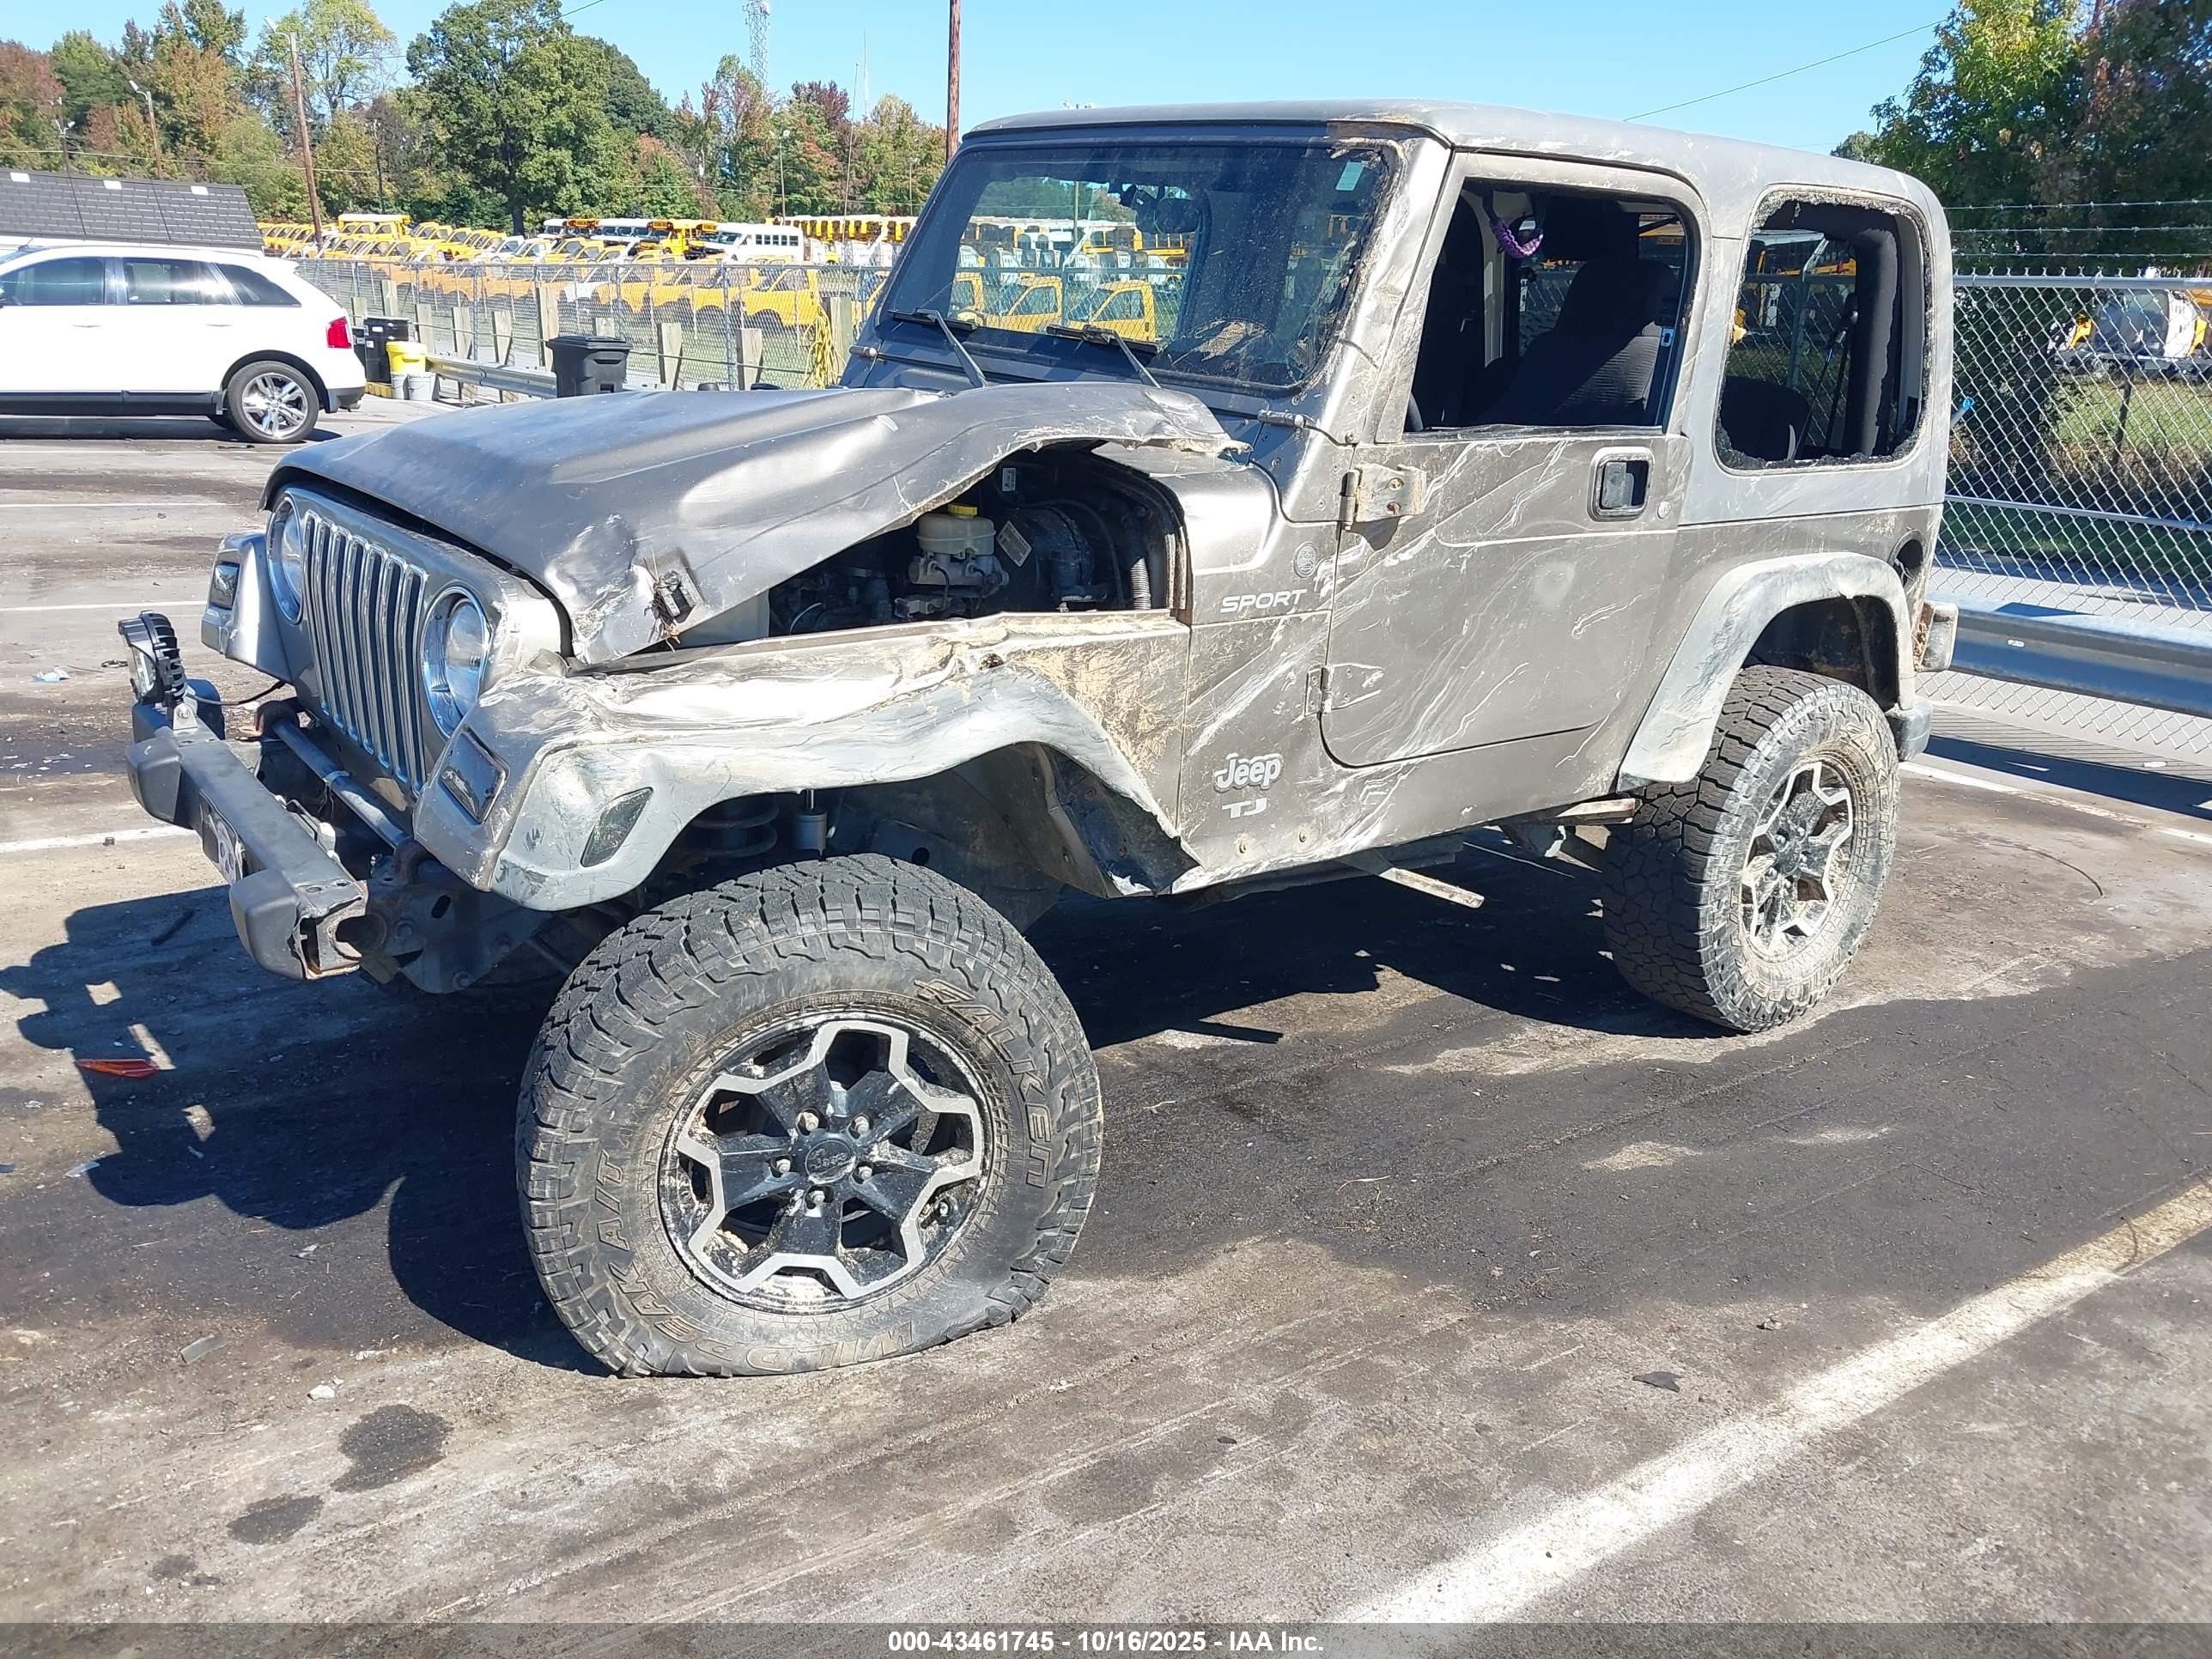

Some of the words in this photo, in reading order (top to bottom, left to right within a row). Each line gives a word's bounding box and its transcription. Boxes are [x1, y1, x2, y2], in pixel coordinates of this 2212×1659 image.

[1220, 589, 1308, 613] SPORT
[1214, 752, 1284, 793] Jeep
[1221, 798, 1267, 818] TJ
[914, 978, 1053, 1188] FALKEN
